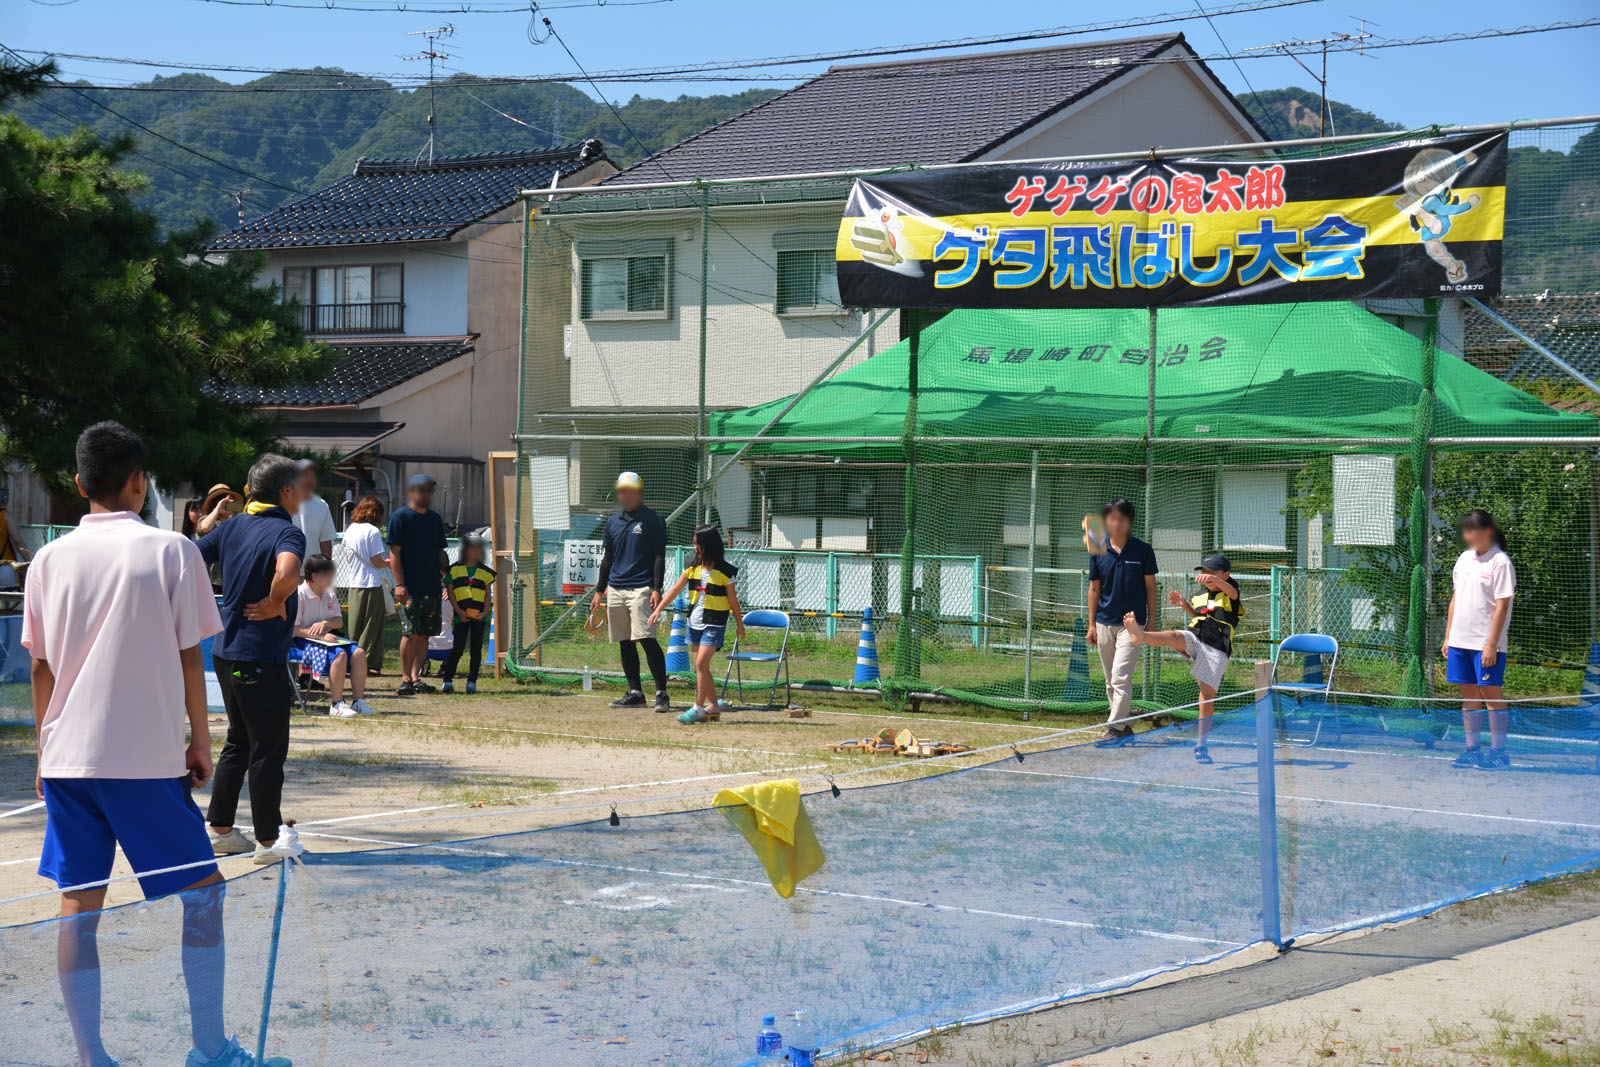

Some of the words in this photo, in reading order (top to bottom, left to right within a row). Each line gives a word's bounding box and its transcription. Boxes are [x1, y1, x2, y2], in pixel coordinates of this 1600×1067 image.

[1006, 164, 1286, 217] ゲゲゲの鬼太郎
[932, 214, 1370, 290] ゲタ飛ばし大会
[569, 571, 586, 582] せん
